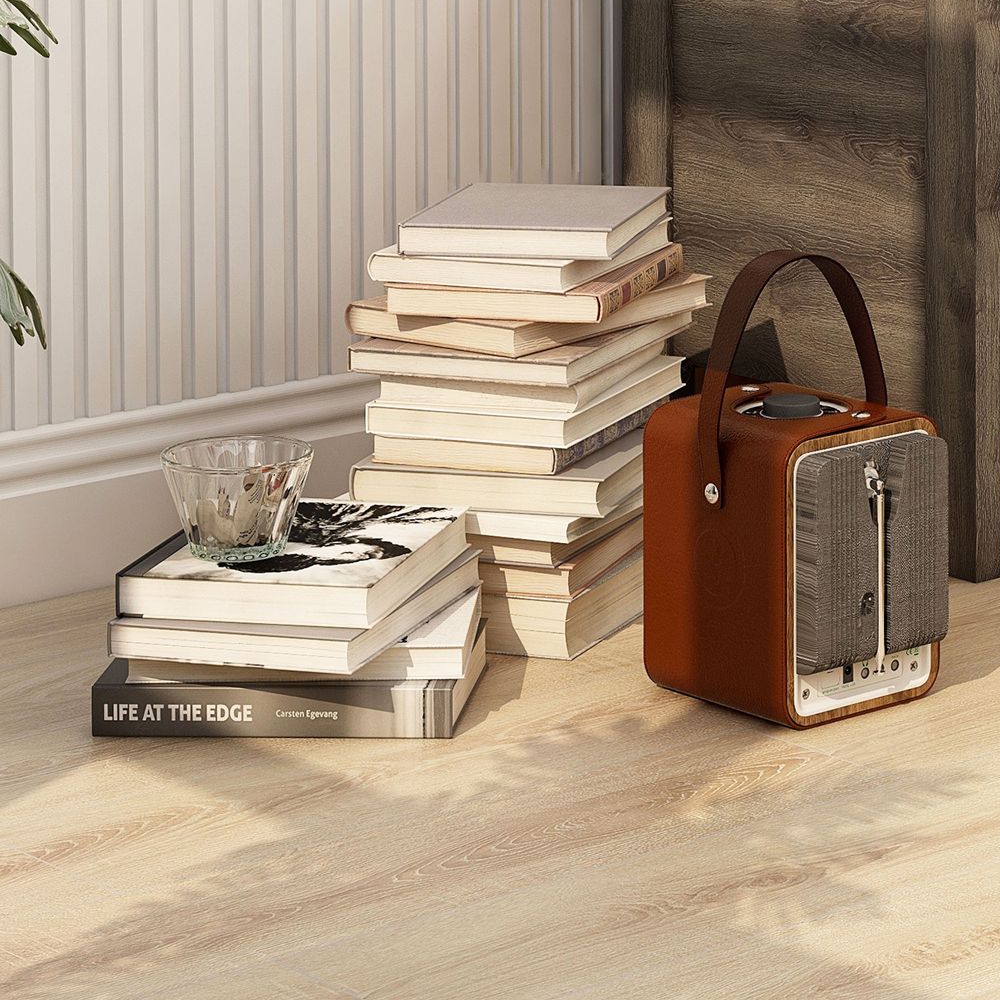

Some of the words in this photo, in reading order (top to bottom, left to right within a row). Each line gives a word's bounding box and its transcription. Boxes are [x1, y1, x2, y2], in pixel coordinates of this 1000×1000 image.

[103, 703, 138, 721] LIFE
[142, 704, 164, 721] AT
[168, 704, 202, 721] THE
[206, 704, 253, 722] EDGE
[275, 709, 304, 718] Carsten
[306, 709, 338, 720] Egevang
